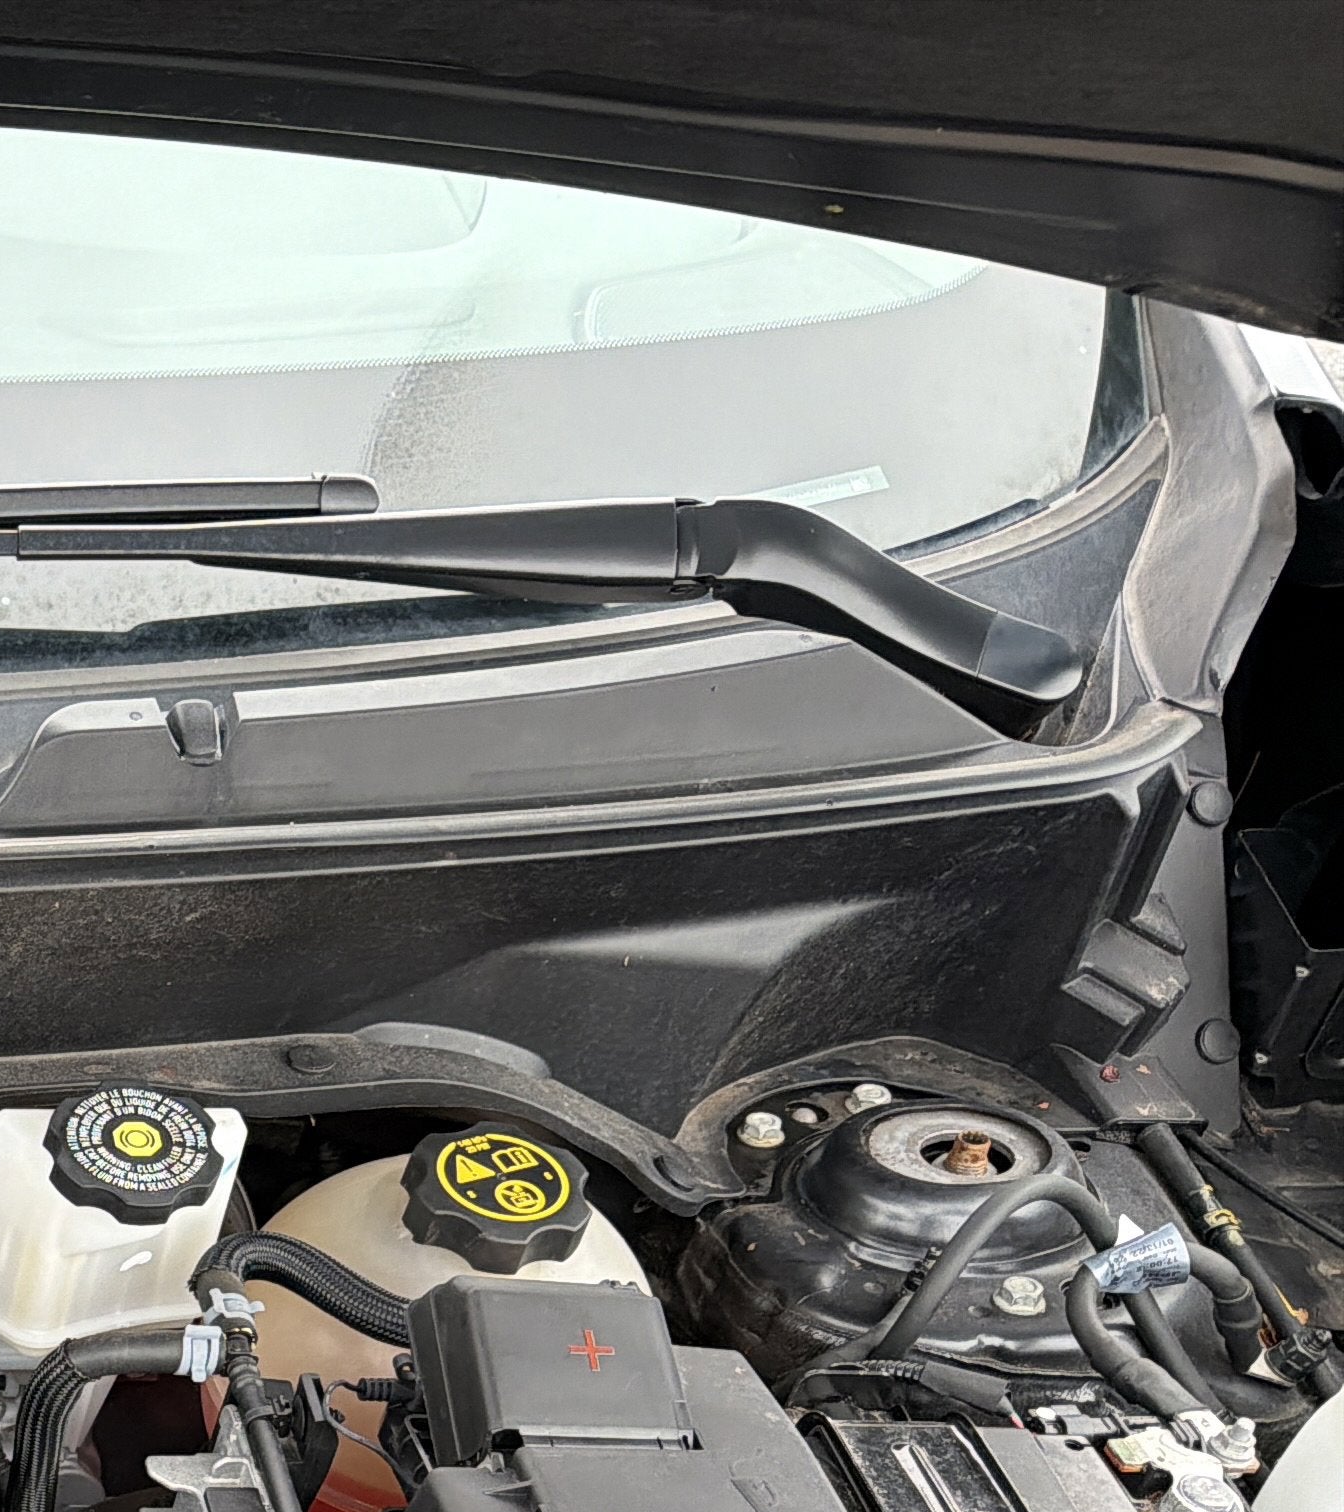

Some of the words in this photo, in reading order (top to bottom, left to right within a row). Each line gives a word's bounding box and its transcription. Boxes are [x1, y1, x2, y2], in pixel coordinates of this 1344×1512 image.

[109, 1089, 120, 1099] LE
[121, 1088, 163, 1102] BOUCHON
[162, 1098, 189, 1115] AVANT
[185, 1113, 197, 1124] LA
[110, 1098, 123, 1107] DU
[125, 1097, 157, 1109] LIQUIDE
[157, 1104, 171, 1115] DE
[137, 1106, 164, 1122] BIDON
[84, 1148, 100, 1162] CAP
[95, 1157, 127, 1178] BEFORE
[88, 1165, 113, 1184] FLUID
[112, 1179, 138, 1191] FROM
[139, 1183, 147, 1192] A
[147, 1179, 179, 1192] SEALED
